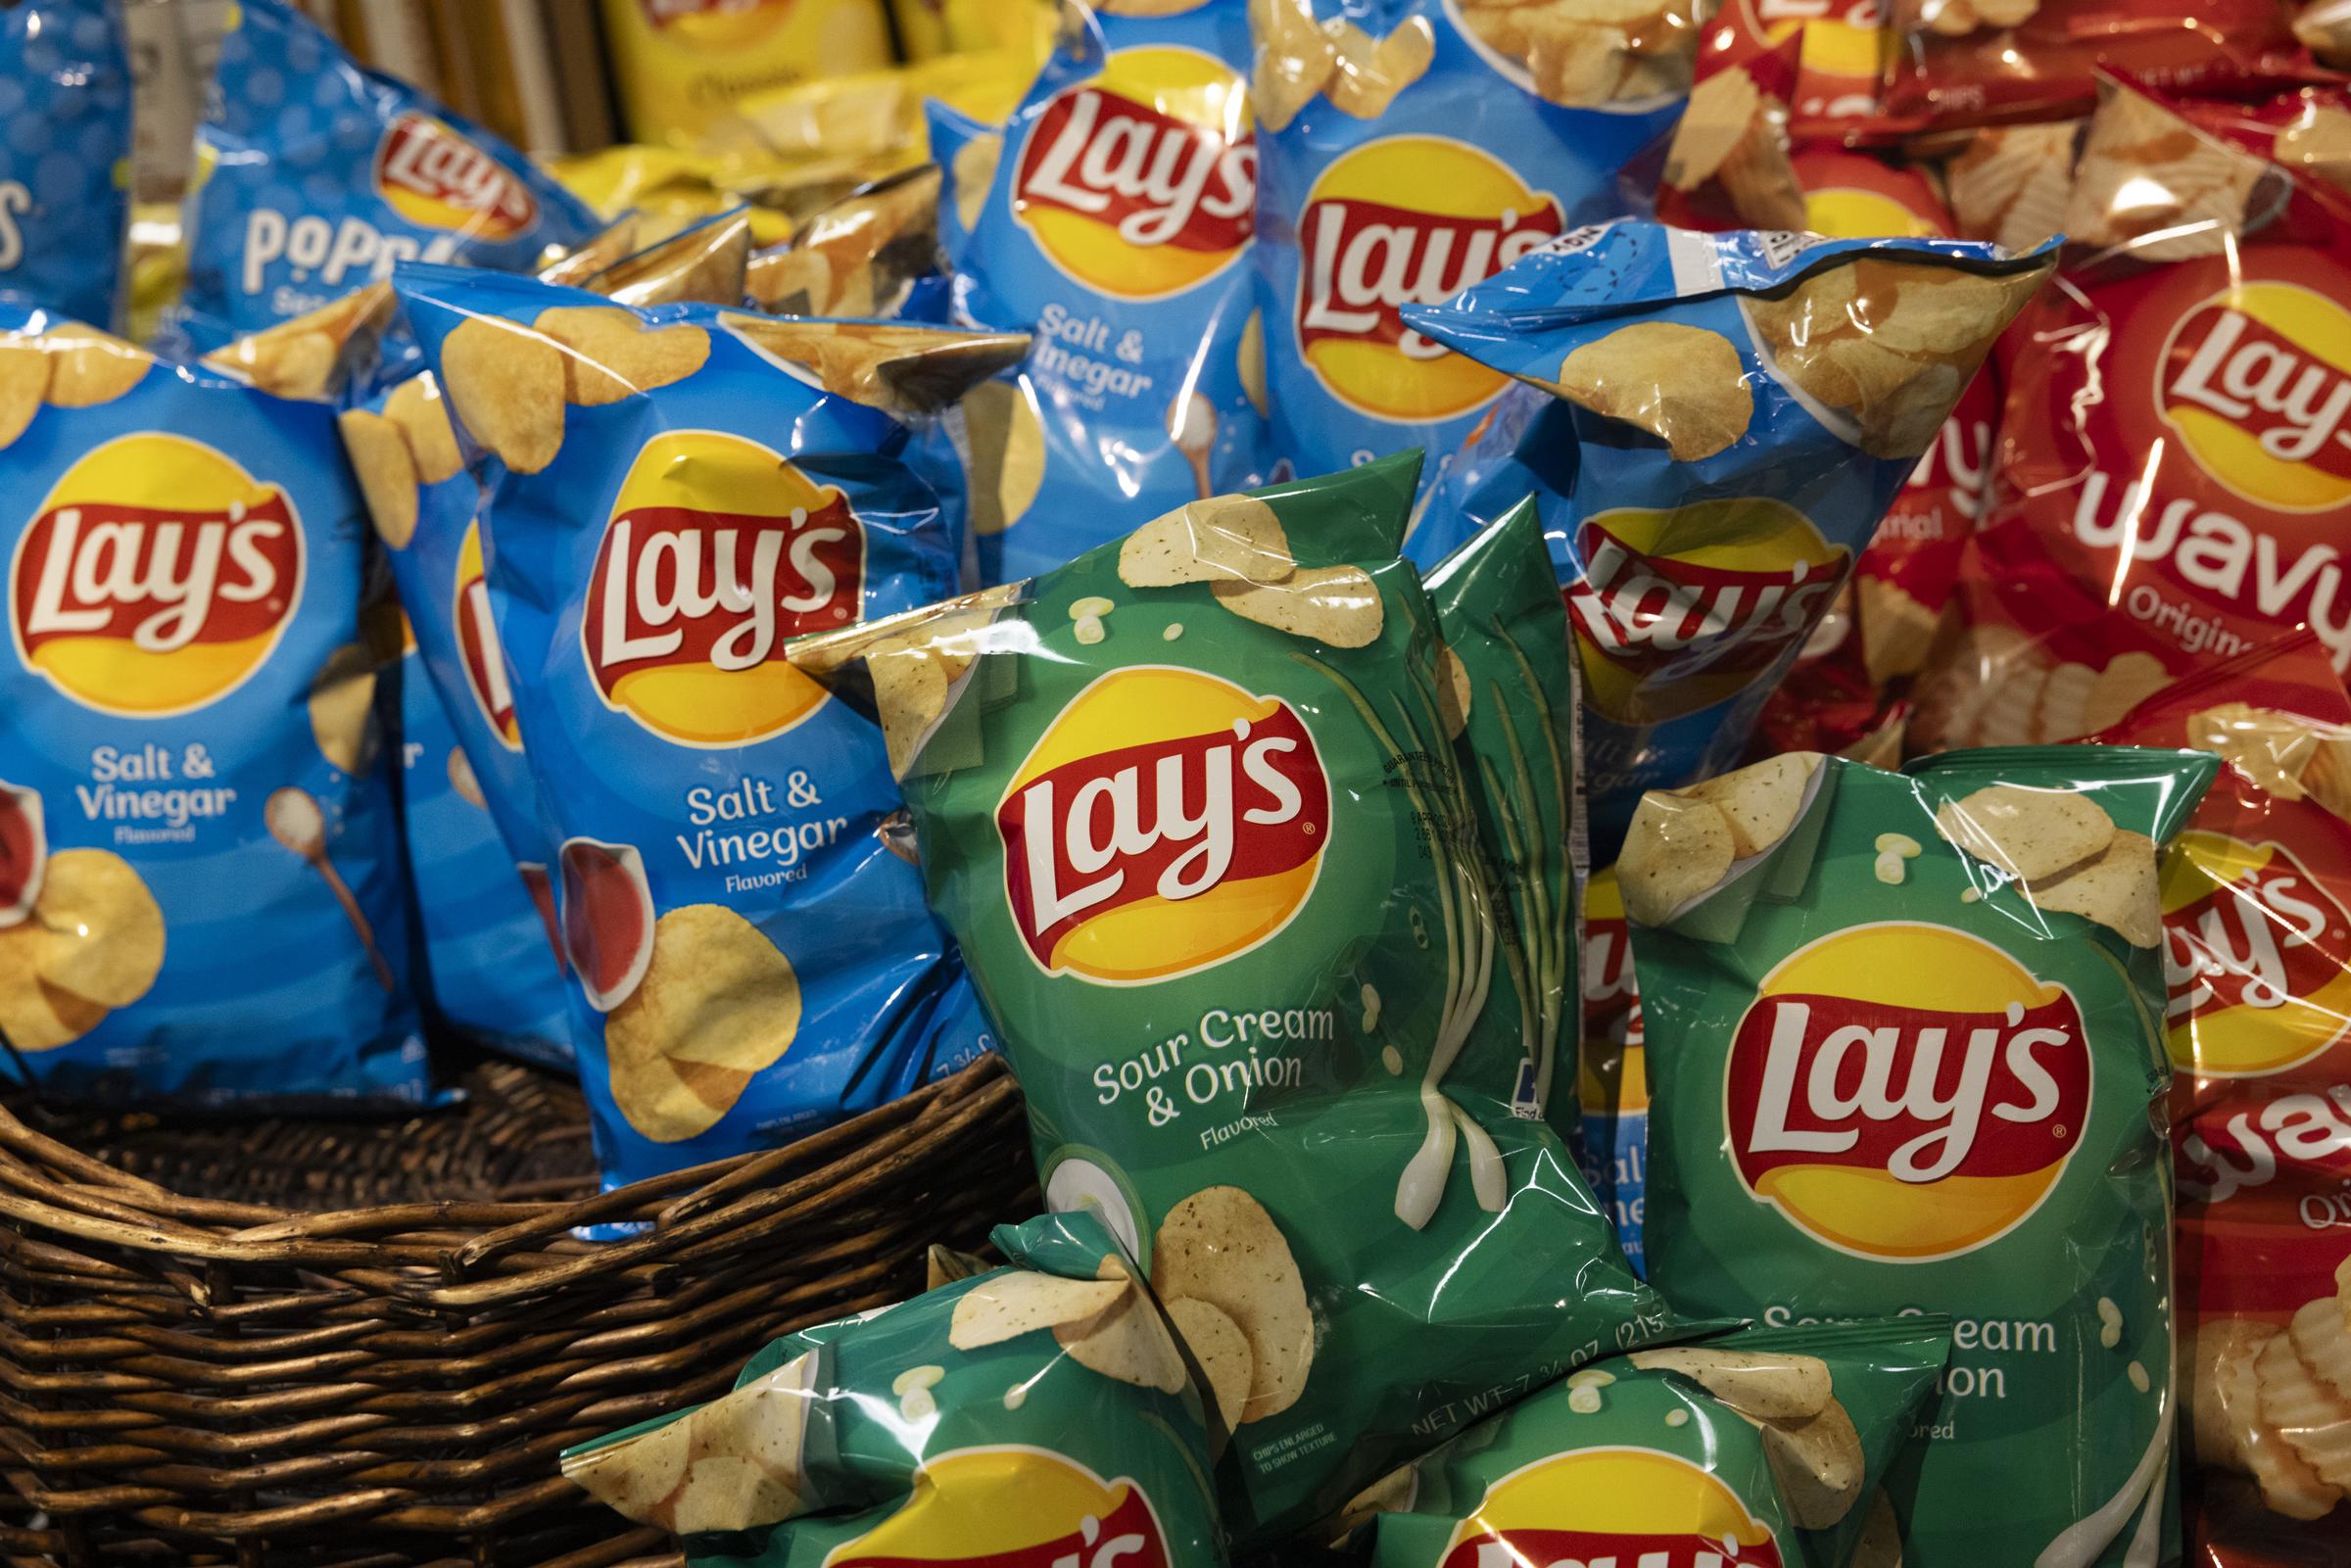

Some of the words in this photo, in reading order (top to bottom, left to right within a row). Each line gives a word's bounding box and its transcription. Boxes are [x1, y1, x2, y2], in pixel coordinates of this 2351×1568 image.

[1026, 90, 1256, 244] Lay's
[1037, 303, 1110, 354] Salt
[1115, 329, 1144, 364] &
[1033, 335, 1153, 400] inegar
[26, 499, 284, 654] Lay's
[600, 506, 847, 672] Lay's
[92, 743, 172, 783] Salt
[182, 742, 216, 780] &
[75, 784, 237, 828] Vinegar
[688, 777, 777, 826] Salt
[787, 771, 823, 809] &
[676, 817, 848, 870] Vinegar
[1024, 718, 1304, 938] Lay's
[725, 862, 808, 894] Flavored
[2162, 867, 2327, 1019] ay's
[1093, 1032, 1189, 1106] Sour
[1200, 1009, 1335, 1048] Cream
[1146, 1085, 1181, 1127] &
[1184, 1045, 1303, 1105] Onion
[1749, 1001, 2071, 1183] Lay's
[1200, 1111, 1279, 1152] Flavored
[1583, 1145, 1644, 1189] Sal
[1253, 1443, 1280, 1461] CHIPS
[1277, 1423, 1324, 1450] ENLARGED
[1412, 1402, 1459, 1437] NET
[1260, 1461, 1272, 1474] TO
[1271, 1449, 1298, 1468] SHOW
[1298, 1431, 1338, 1456] TEXTURE
